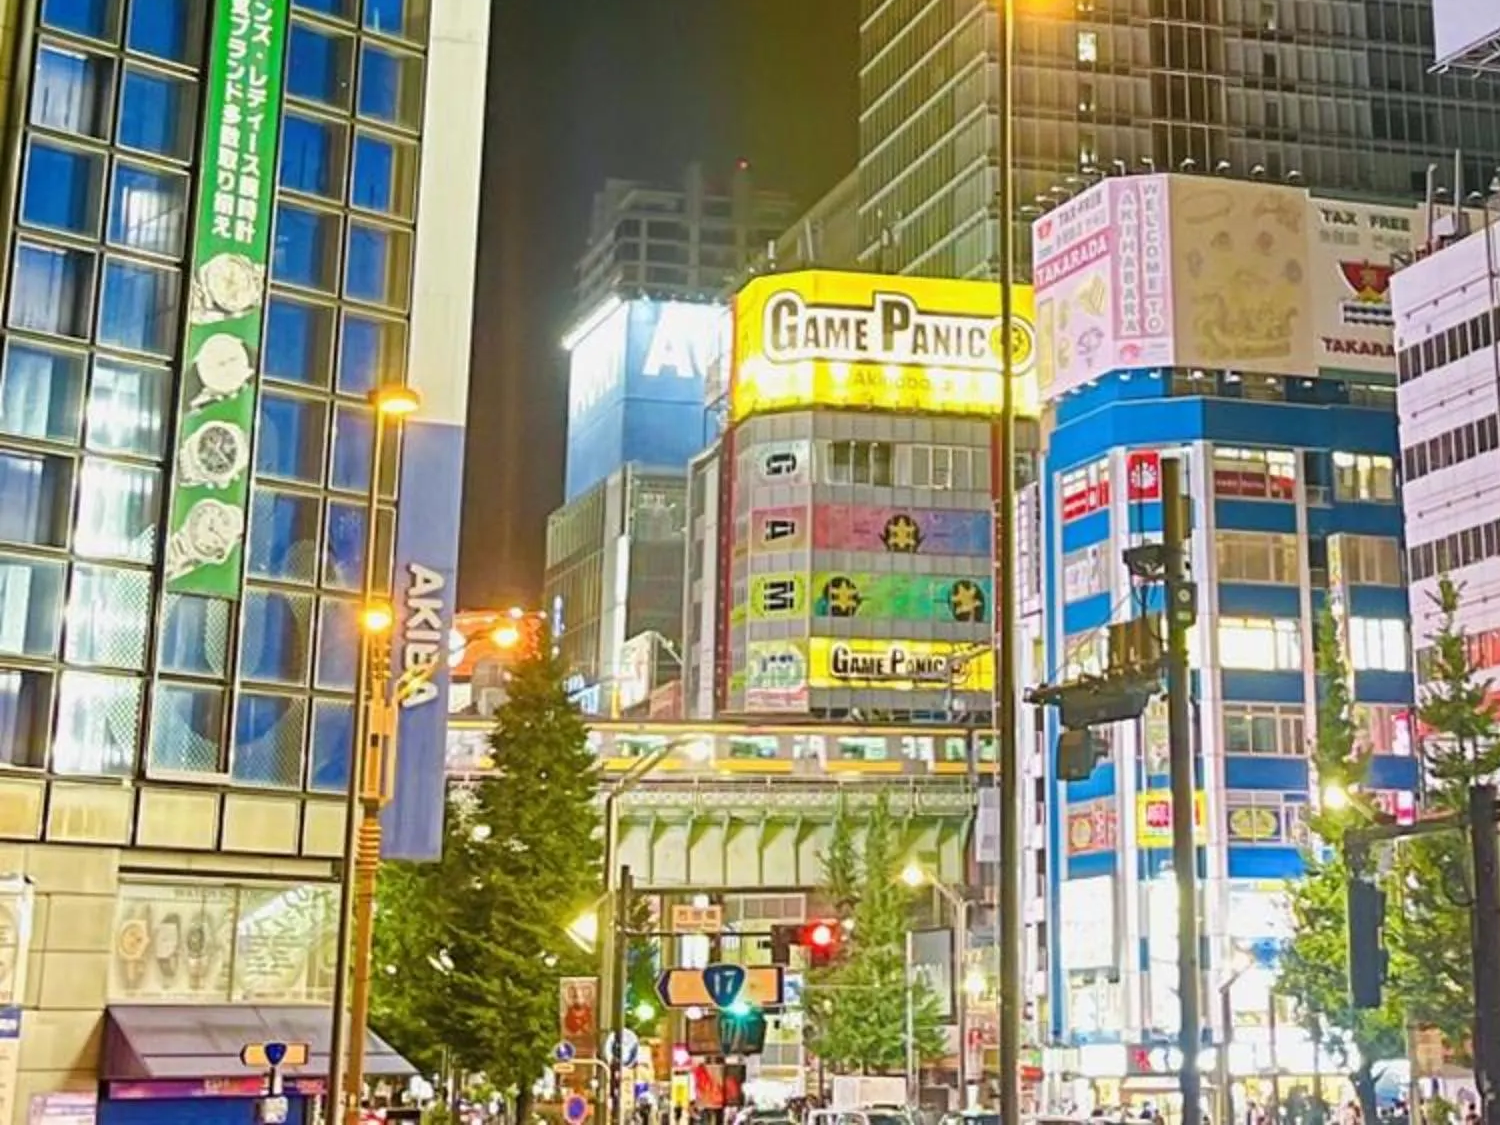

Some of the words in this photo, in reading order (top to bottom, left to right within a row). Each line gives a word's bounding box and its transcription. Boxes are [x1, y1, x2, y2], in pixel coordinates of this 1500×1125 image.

[1143, 184, 1162, 292] WELCOME
[1320, 207, 1358, 226] TAX
[1369, 214, 1410, 233] FREE
[1037, 234, 1108, 286] TAKARADA
[1118, 190, 1140, 335] AKIHABARA
[771, 298, 868, 352] GAME
[881, 299, 986, 359] PANIC
[1144, 299, 1164, 333] TO
[399, 562, 446, 709] AKIBA
[832, 645, 885, 675] GAME
[891, 648, 945, 675] PANIC
[714, 970, 738, 996] 17
